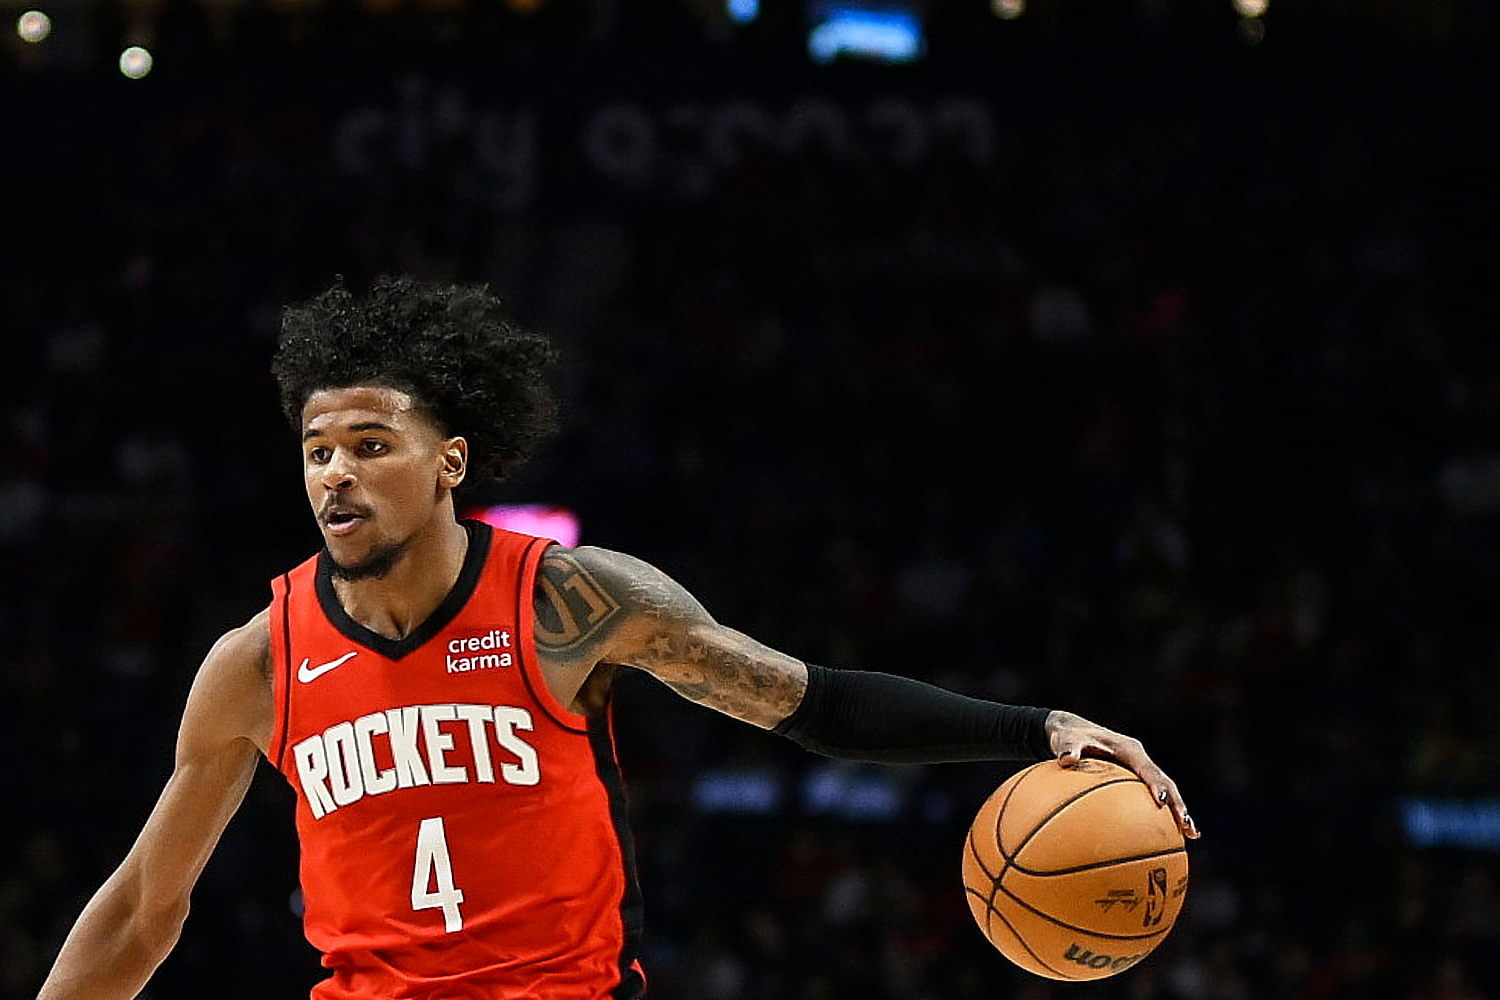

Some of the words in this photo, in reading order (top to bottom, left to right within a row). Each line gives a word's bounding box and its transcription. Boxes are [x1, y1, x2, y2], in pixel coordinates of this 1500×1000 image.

[446, 652, 512, 674] karma
[448, 630, 511, 654] credit
[293, 703, 541, 821] ROCKETS
[411, 815, 465, 934] 4
